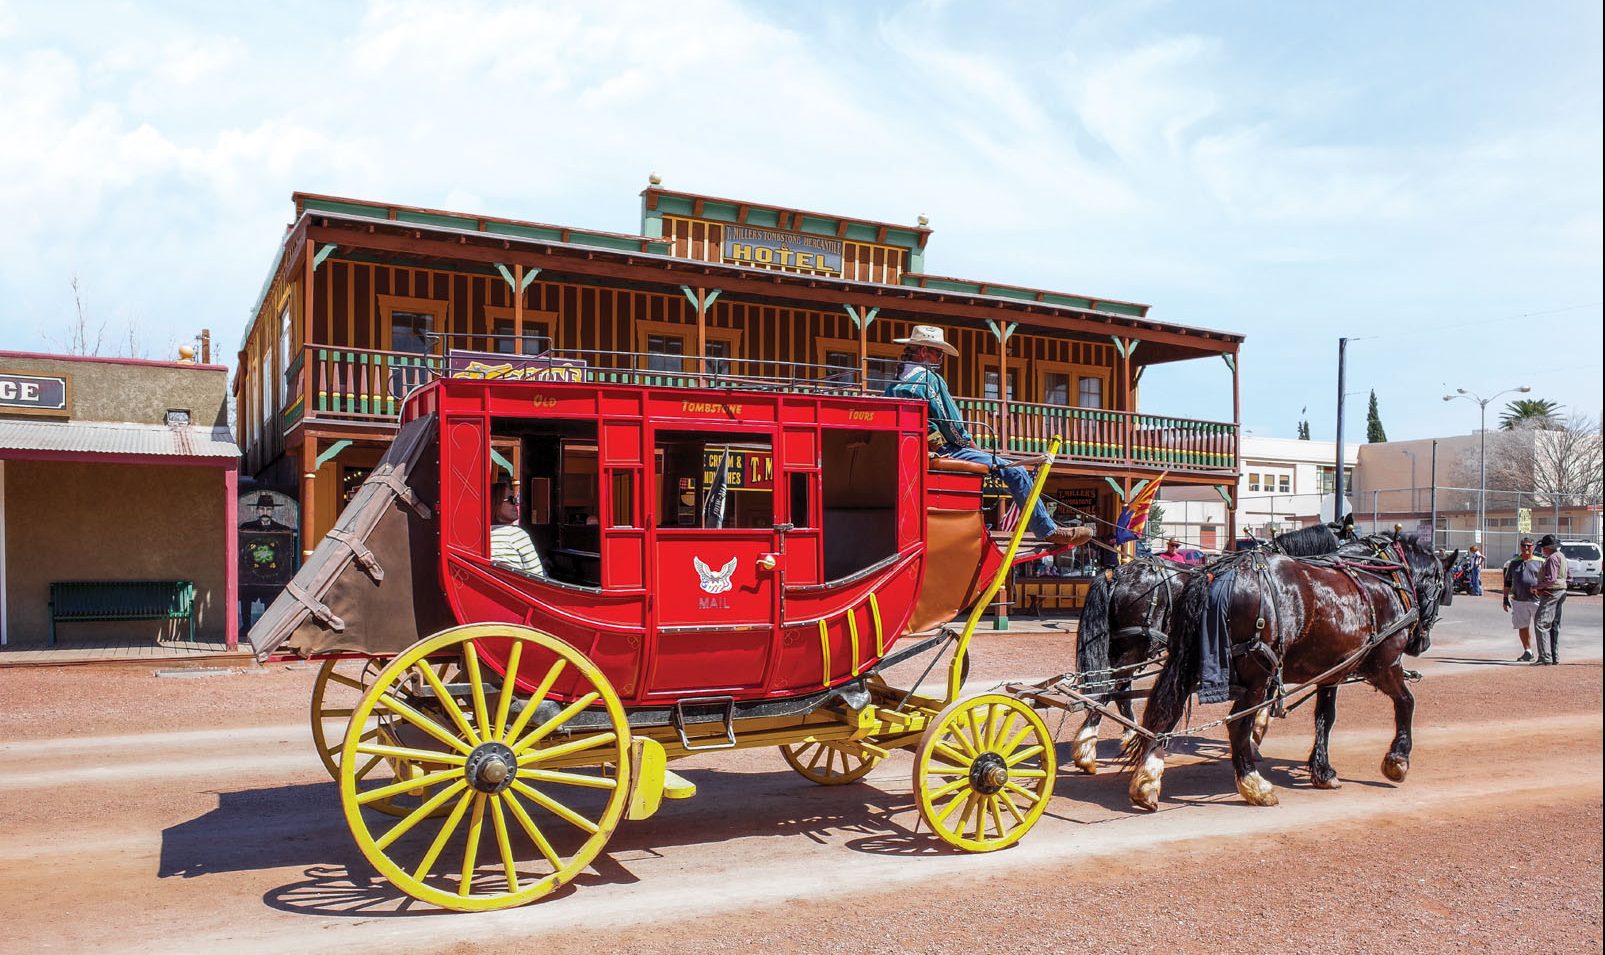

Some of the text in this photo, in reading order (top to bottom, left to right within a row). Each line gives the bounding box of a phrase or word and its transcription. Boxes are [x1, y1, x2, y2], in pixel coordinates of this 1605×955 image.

[733, 227, 762, 240] MILLER'S
[763, 231, 801, 244] TOMBSTONE
[803, 236, 842, 255] MERCANTILE
[732, 242, 834, 271] HOTEL
[533, 394, 557, 408] OLD
[848, 408, 875, 421] TOURS
[736, 456, 742, 468] &
[699, 597, 730, 609] MAIL
